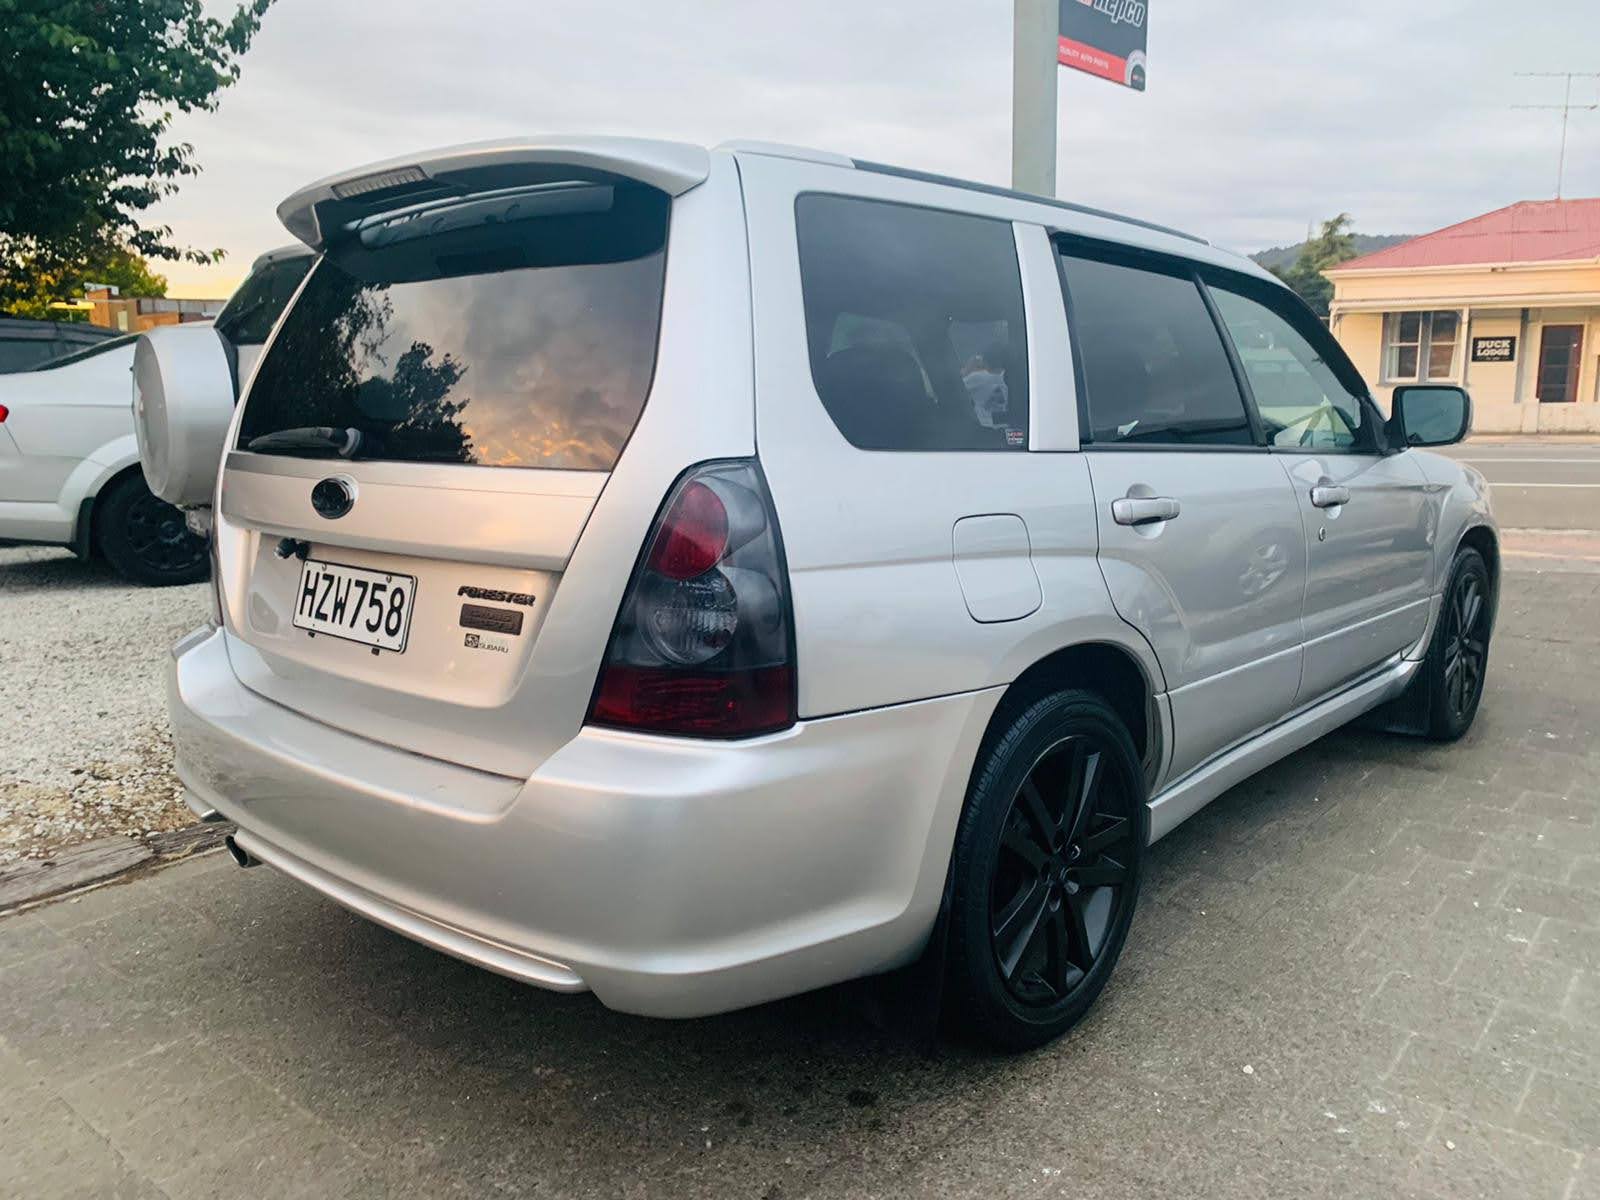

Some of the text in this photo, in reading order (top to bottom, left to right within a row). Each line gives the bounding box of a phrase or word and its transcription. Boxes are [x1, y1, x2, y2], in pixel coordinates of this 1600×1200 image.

[1477, 340, 1511, 348] BUCK
[1477, 348, 1511, 357] LODGE
[457, 585, 536, 607] FORESTER
[299, 570, 405, 637] HZW758
[479, 642, 509, 654] SUBARU
